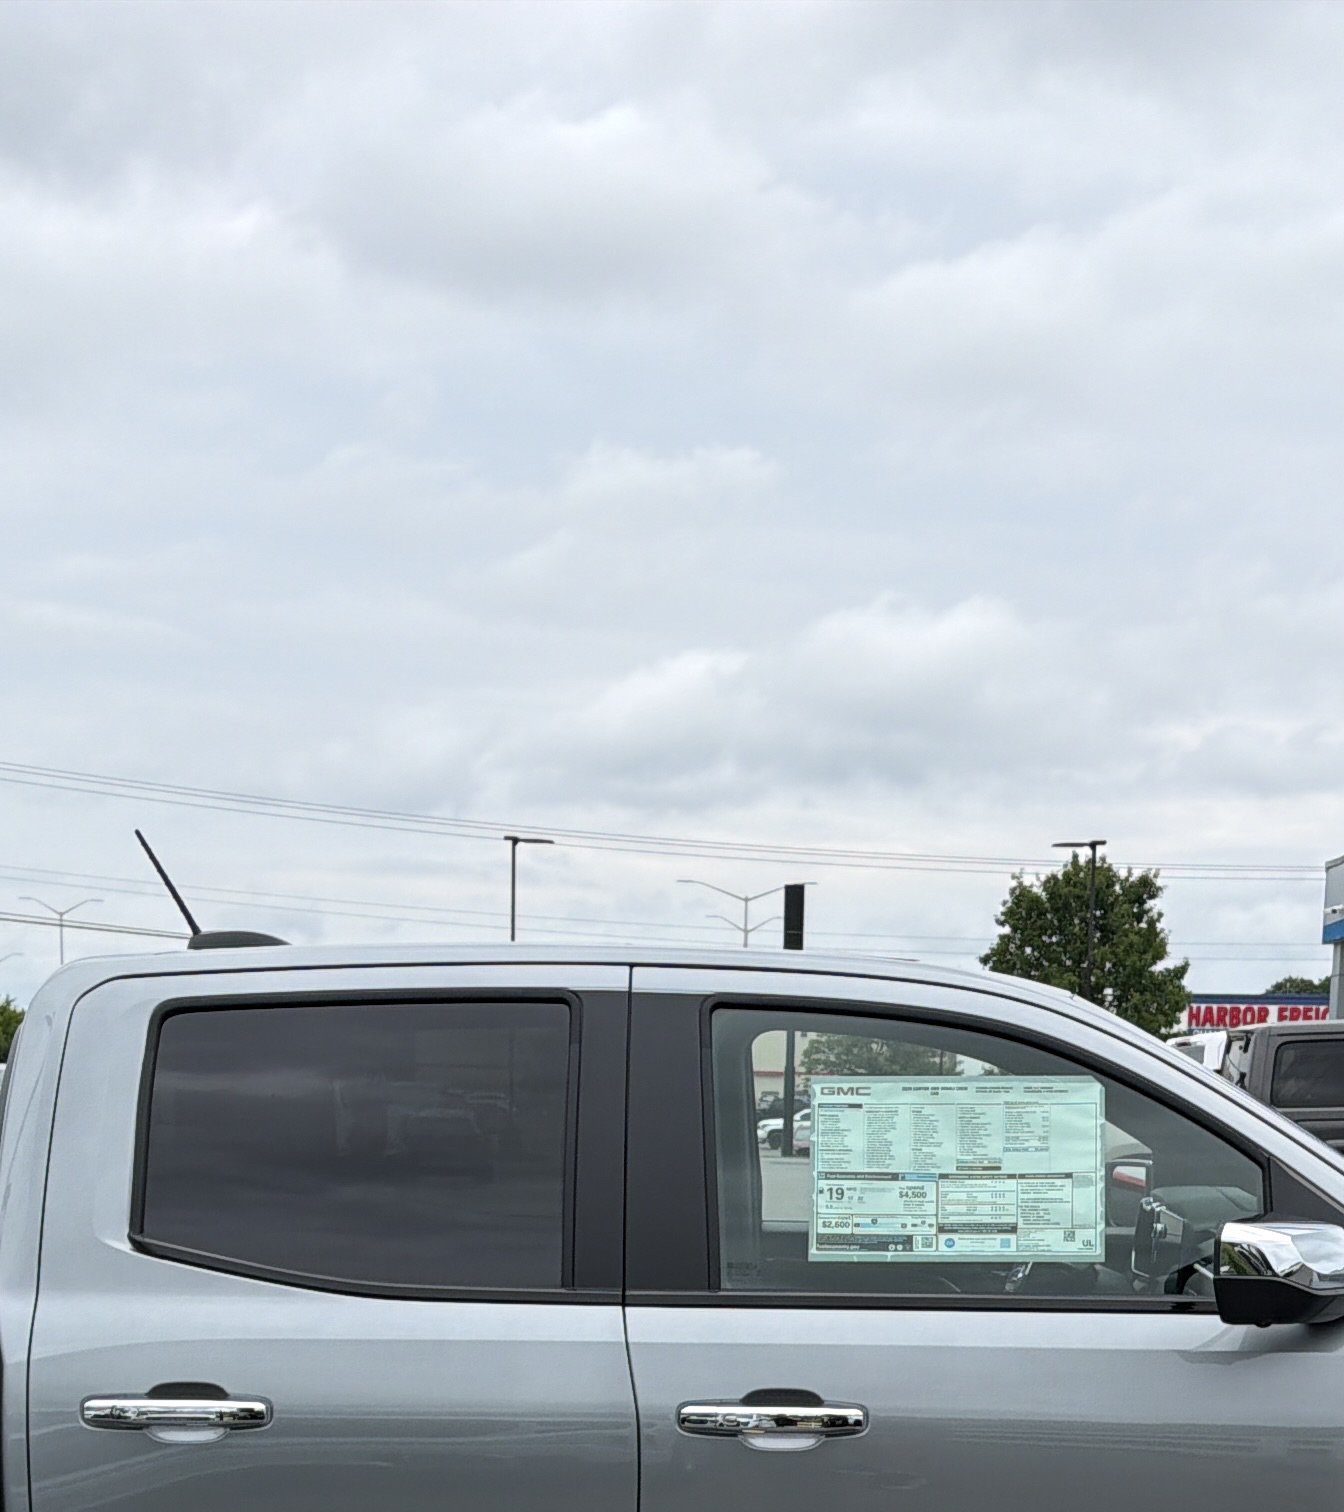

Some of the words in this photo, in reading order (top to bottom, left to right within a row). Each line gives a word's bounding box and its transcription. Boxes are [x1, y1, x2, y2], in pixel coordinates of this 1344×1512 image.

[1188, 1005, 1270, 1028] HARBOR
[820, 1086, 872, 1097] GMC
[826, 1187, 845, 1201] 19
[898, 1190, 928, 1199] $4,500
